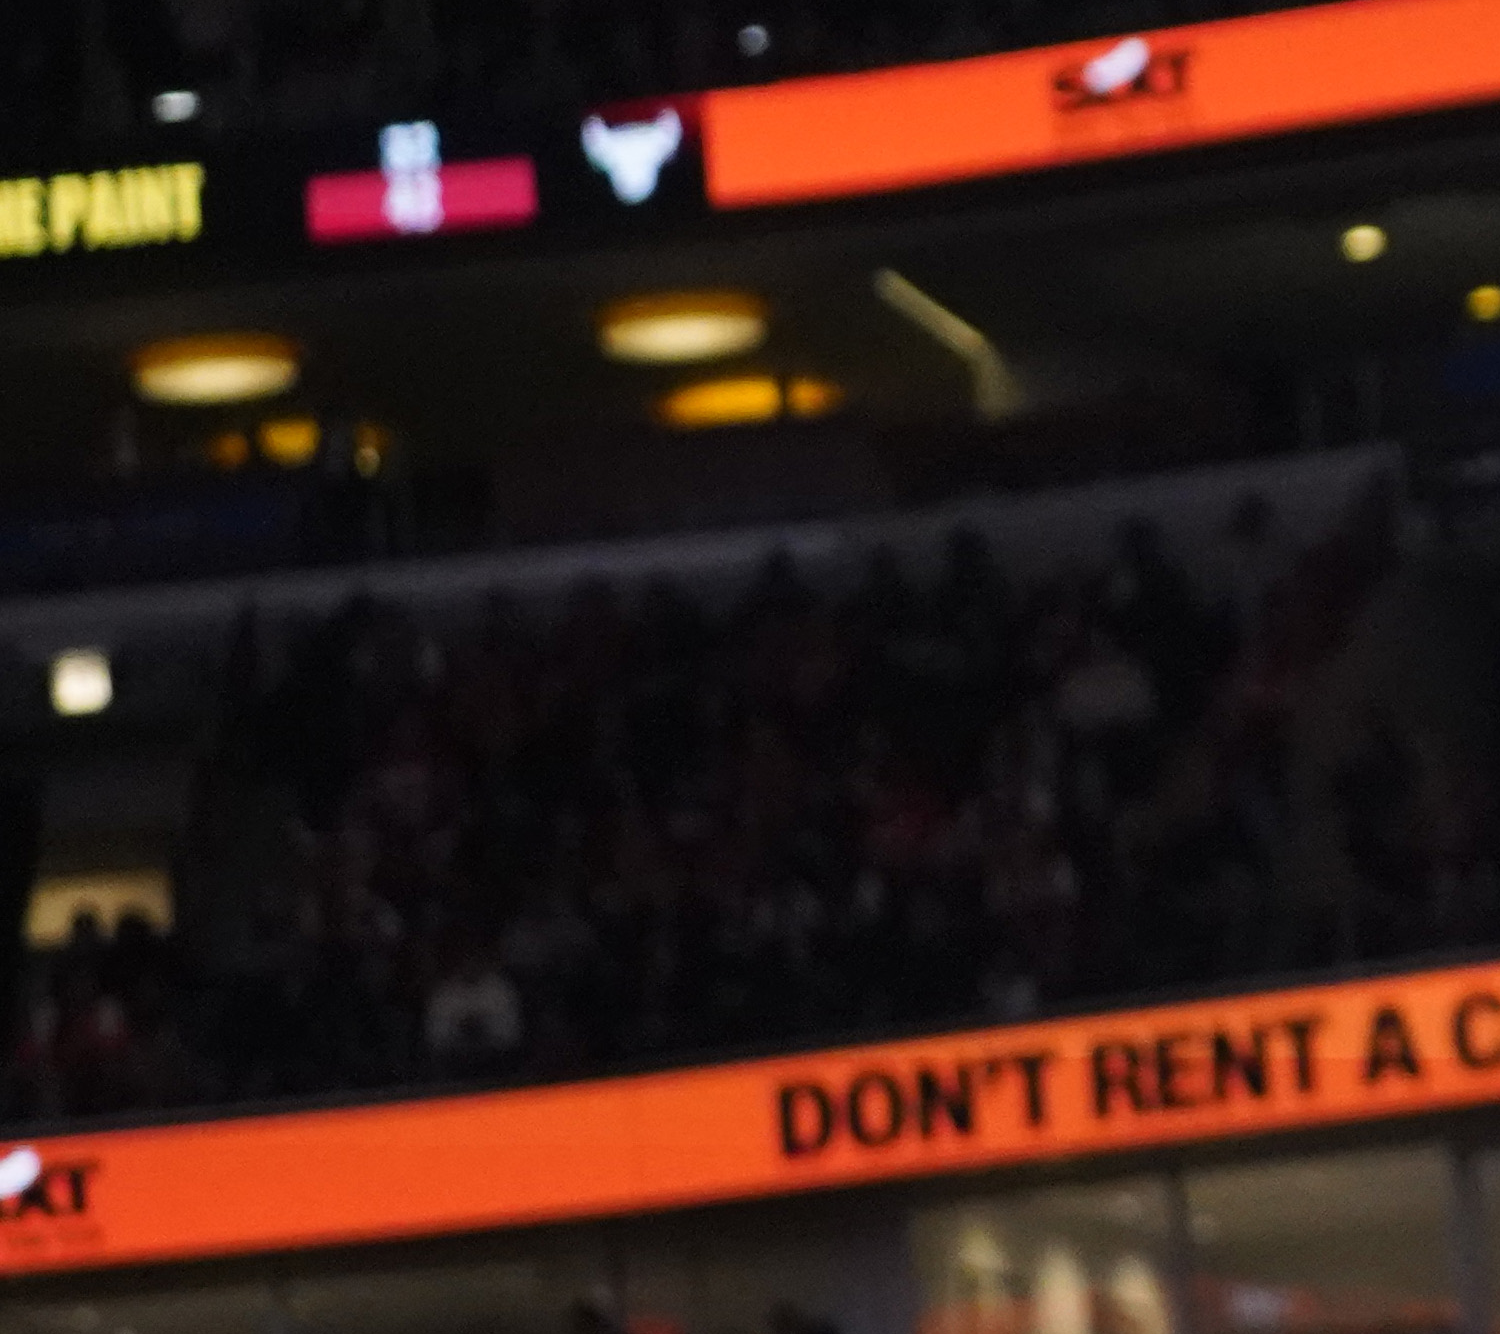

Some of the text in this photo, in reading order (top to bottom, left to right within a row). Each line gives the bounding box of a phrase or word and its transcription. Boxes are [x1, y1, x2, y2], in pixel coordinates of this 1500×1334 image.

[776, 1048, 1063, 1161] DON'T
[1091, 1017, 1323, 1119] RENT
[1364, 1006, 1420, 1083] A
